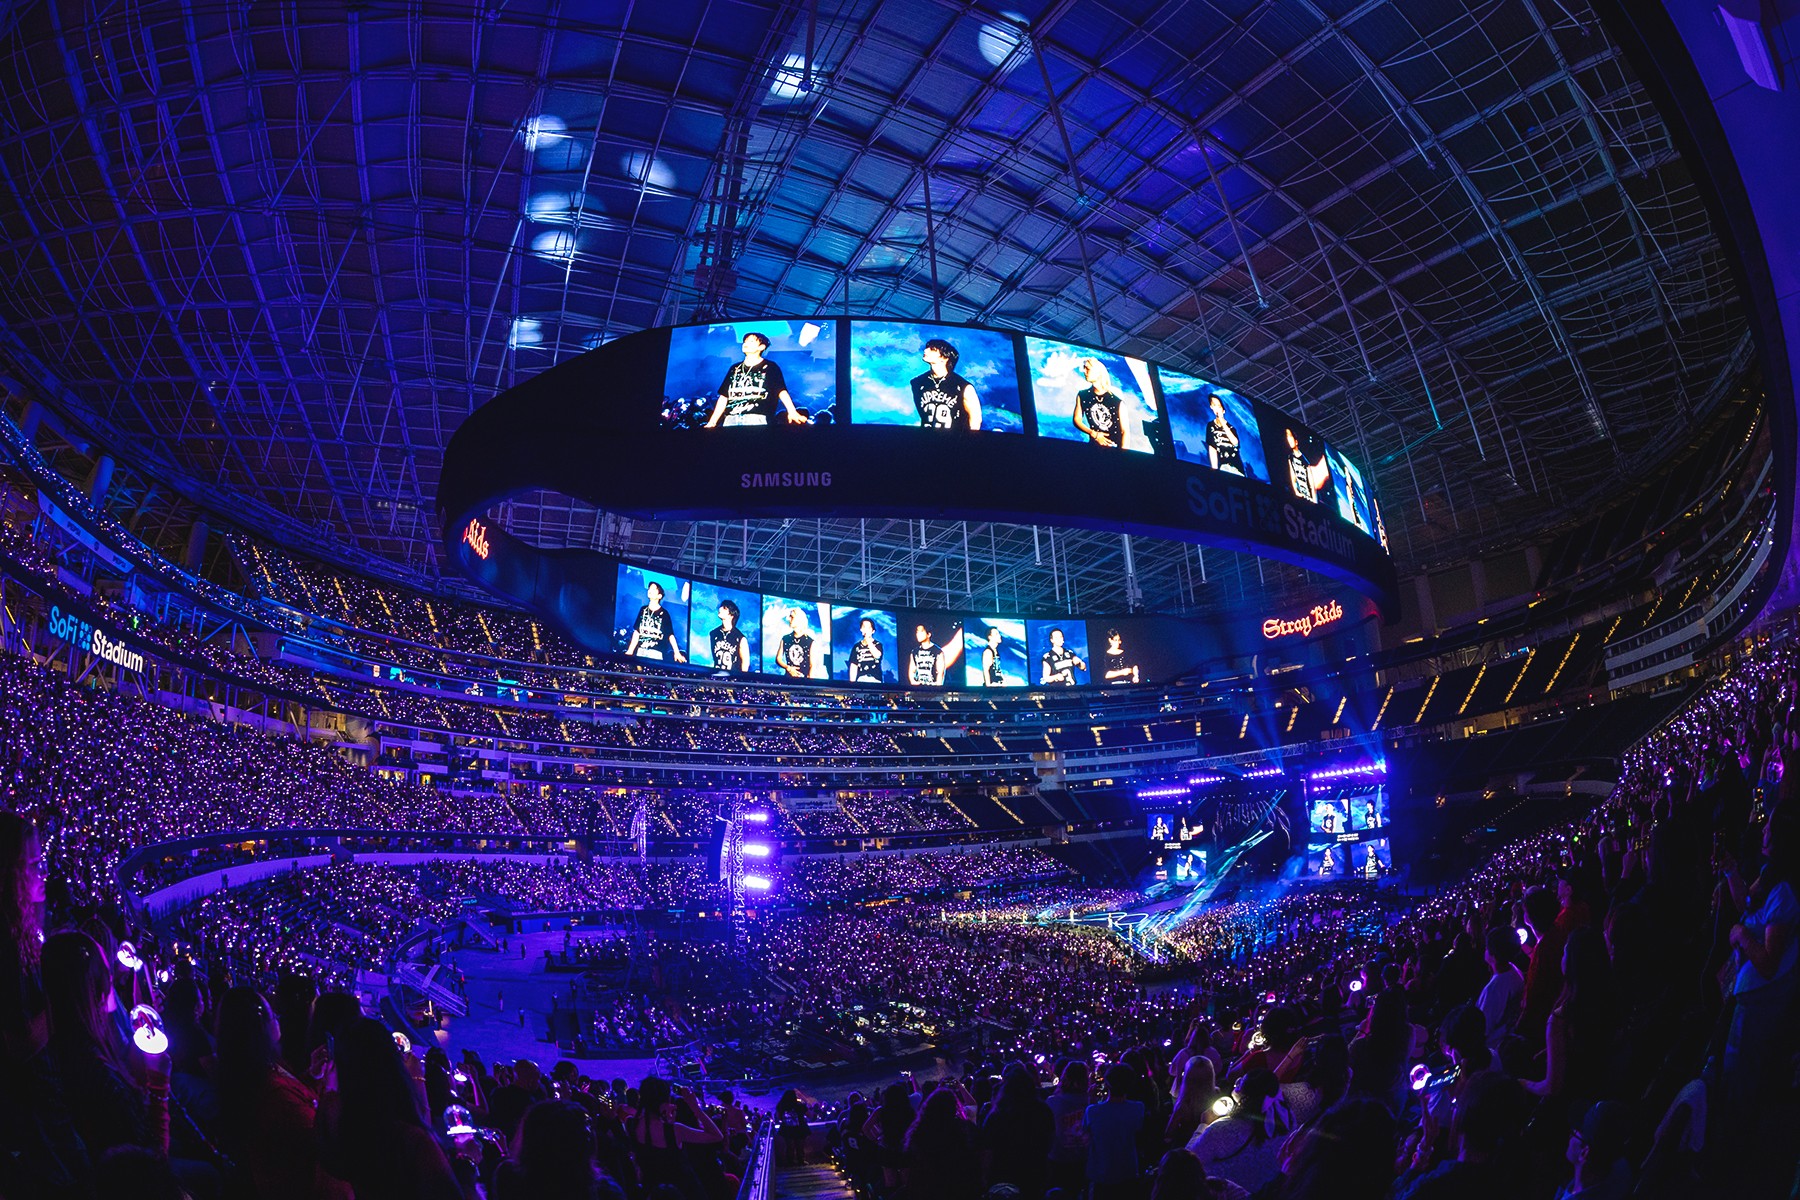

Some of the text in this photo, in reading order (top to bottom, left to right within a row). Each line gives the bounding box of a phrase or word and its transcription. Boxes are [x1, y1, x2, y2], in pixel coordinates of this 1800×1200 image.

[920, 389, 958, 409] SUPREME
[740, 471, 832, 489] SAMSUNG
[1186, 475, 1254, 528] SoFi
[1283, 503, 1357, 562] Stadium
[1262, 599, 1343, 639] Stray Kids
[49, 605, 144, 674] SoFi Stadium
